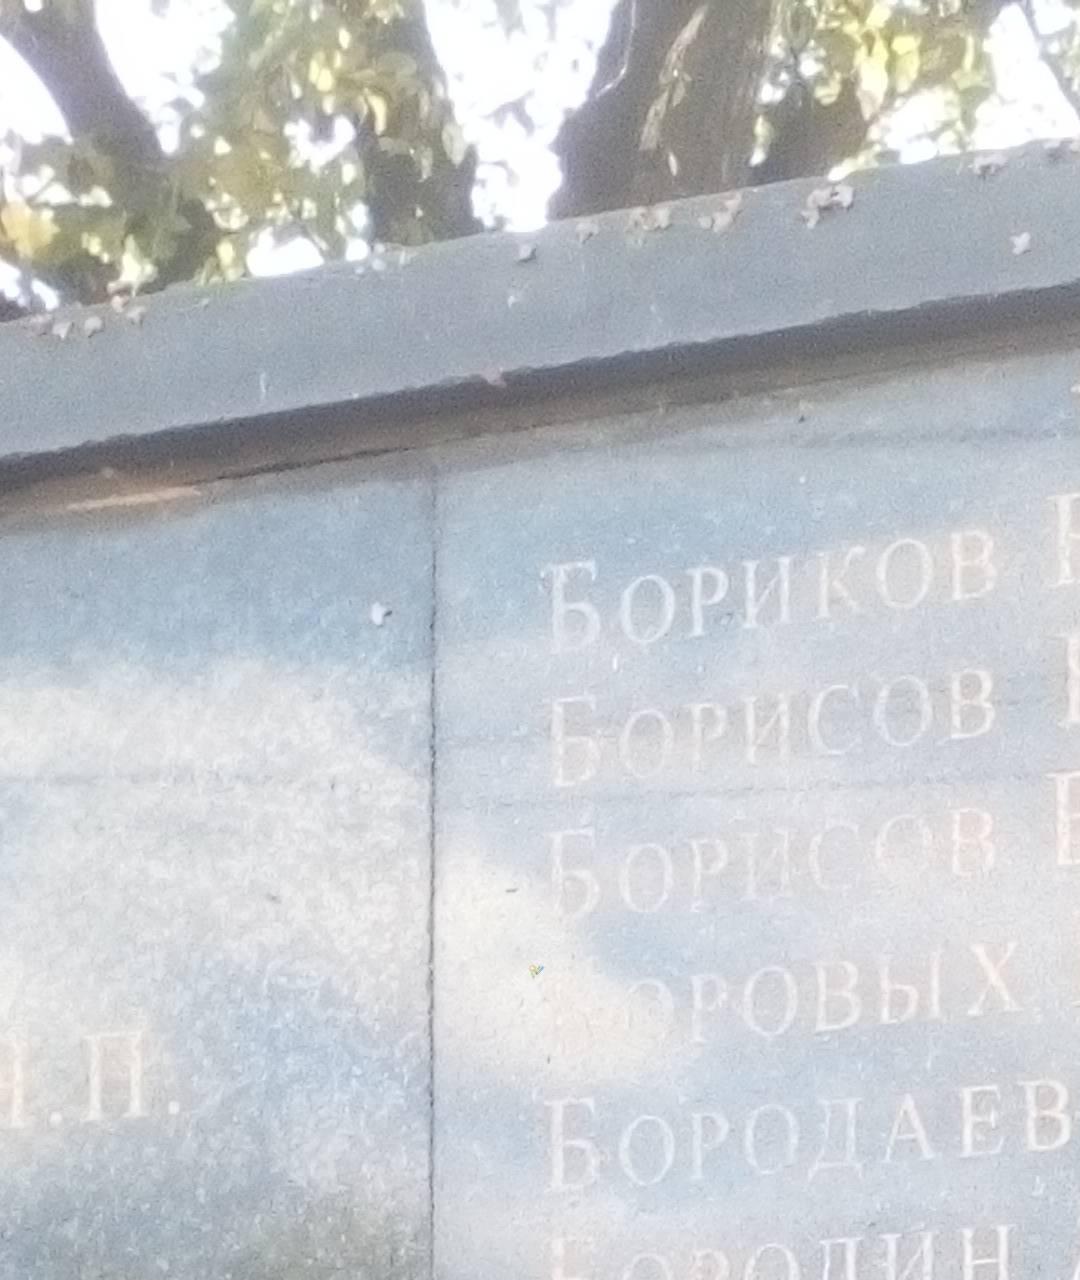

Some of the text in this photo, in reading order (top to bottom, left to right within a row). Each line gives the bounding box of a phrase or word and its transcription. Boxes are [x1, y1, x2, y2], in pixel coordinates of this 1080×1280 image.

[539, 529, 998, 655] БОРИКОВ
[546, 668, 998, 788] БОРИСОВ
[544, 1079, 1073, 1194] БОРОДАЕВ
